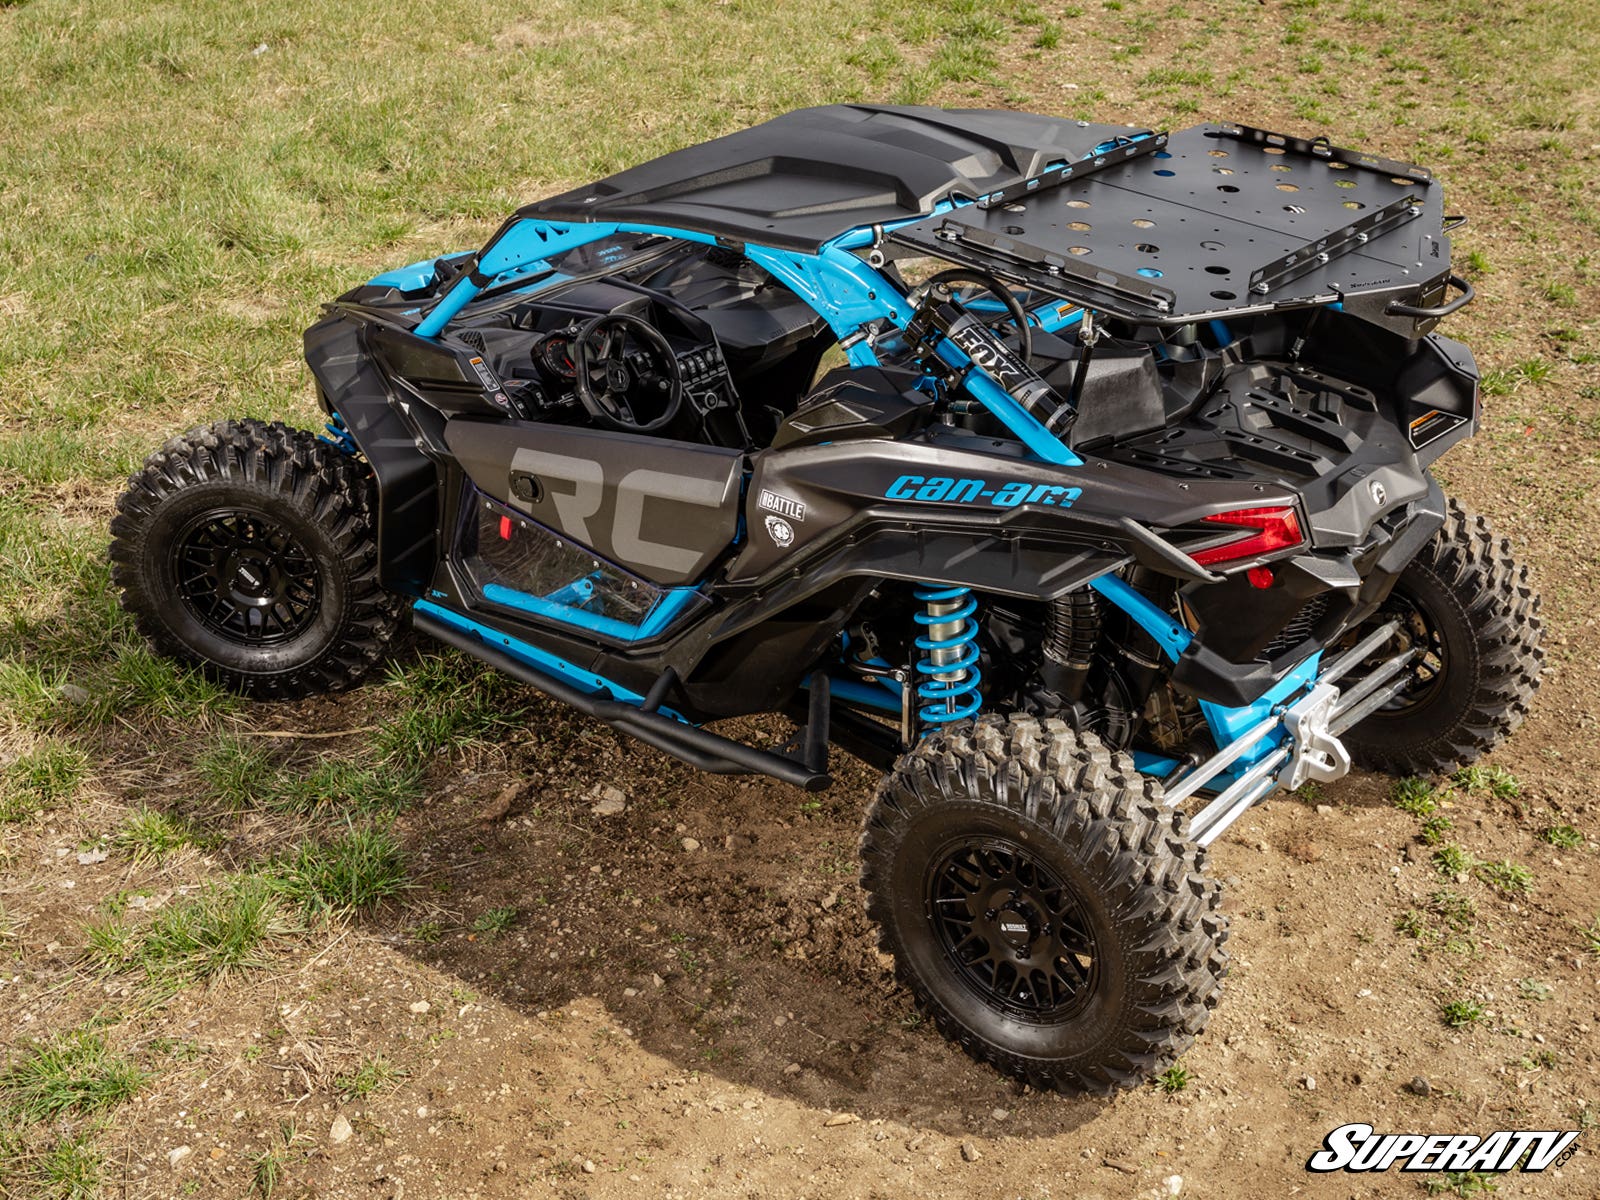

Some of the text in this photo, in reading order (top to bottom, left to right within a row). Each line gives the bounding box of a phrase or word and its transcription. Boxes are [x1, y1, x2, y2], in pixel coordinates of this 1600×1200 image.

[953, 327, 1019, 379] FOX
[508, 447, 725, 574] RC
[767, 494, 804, 518] BATTLE
[885, 475, 1083, 508] can-am
